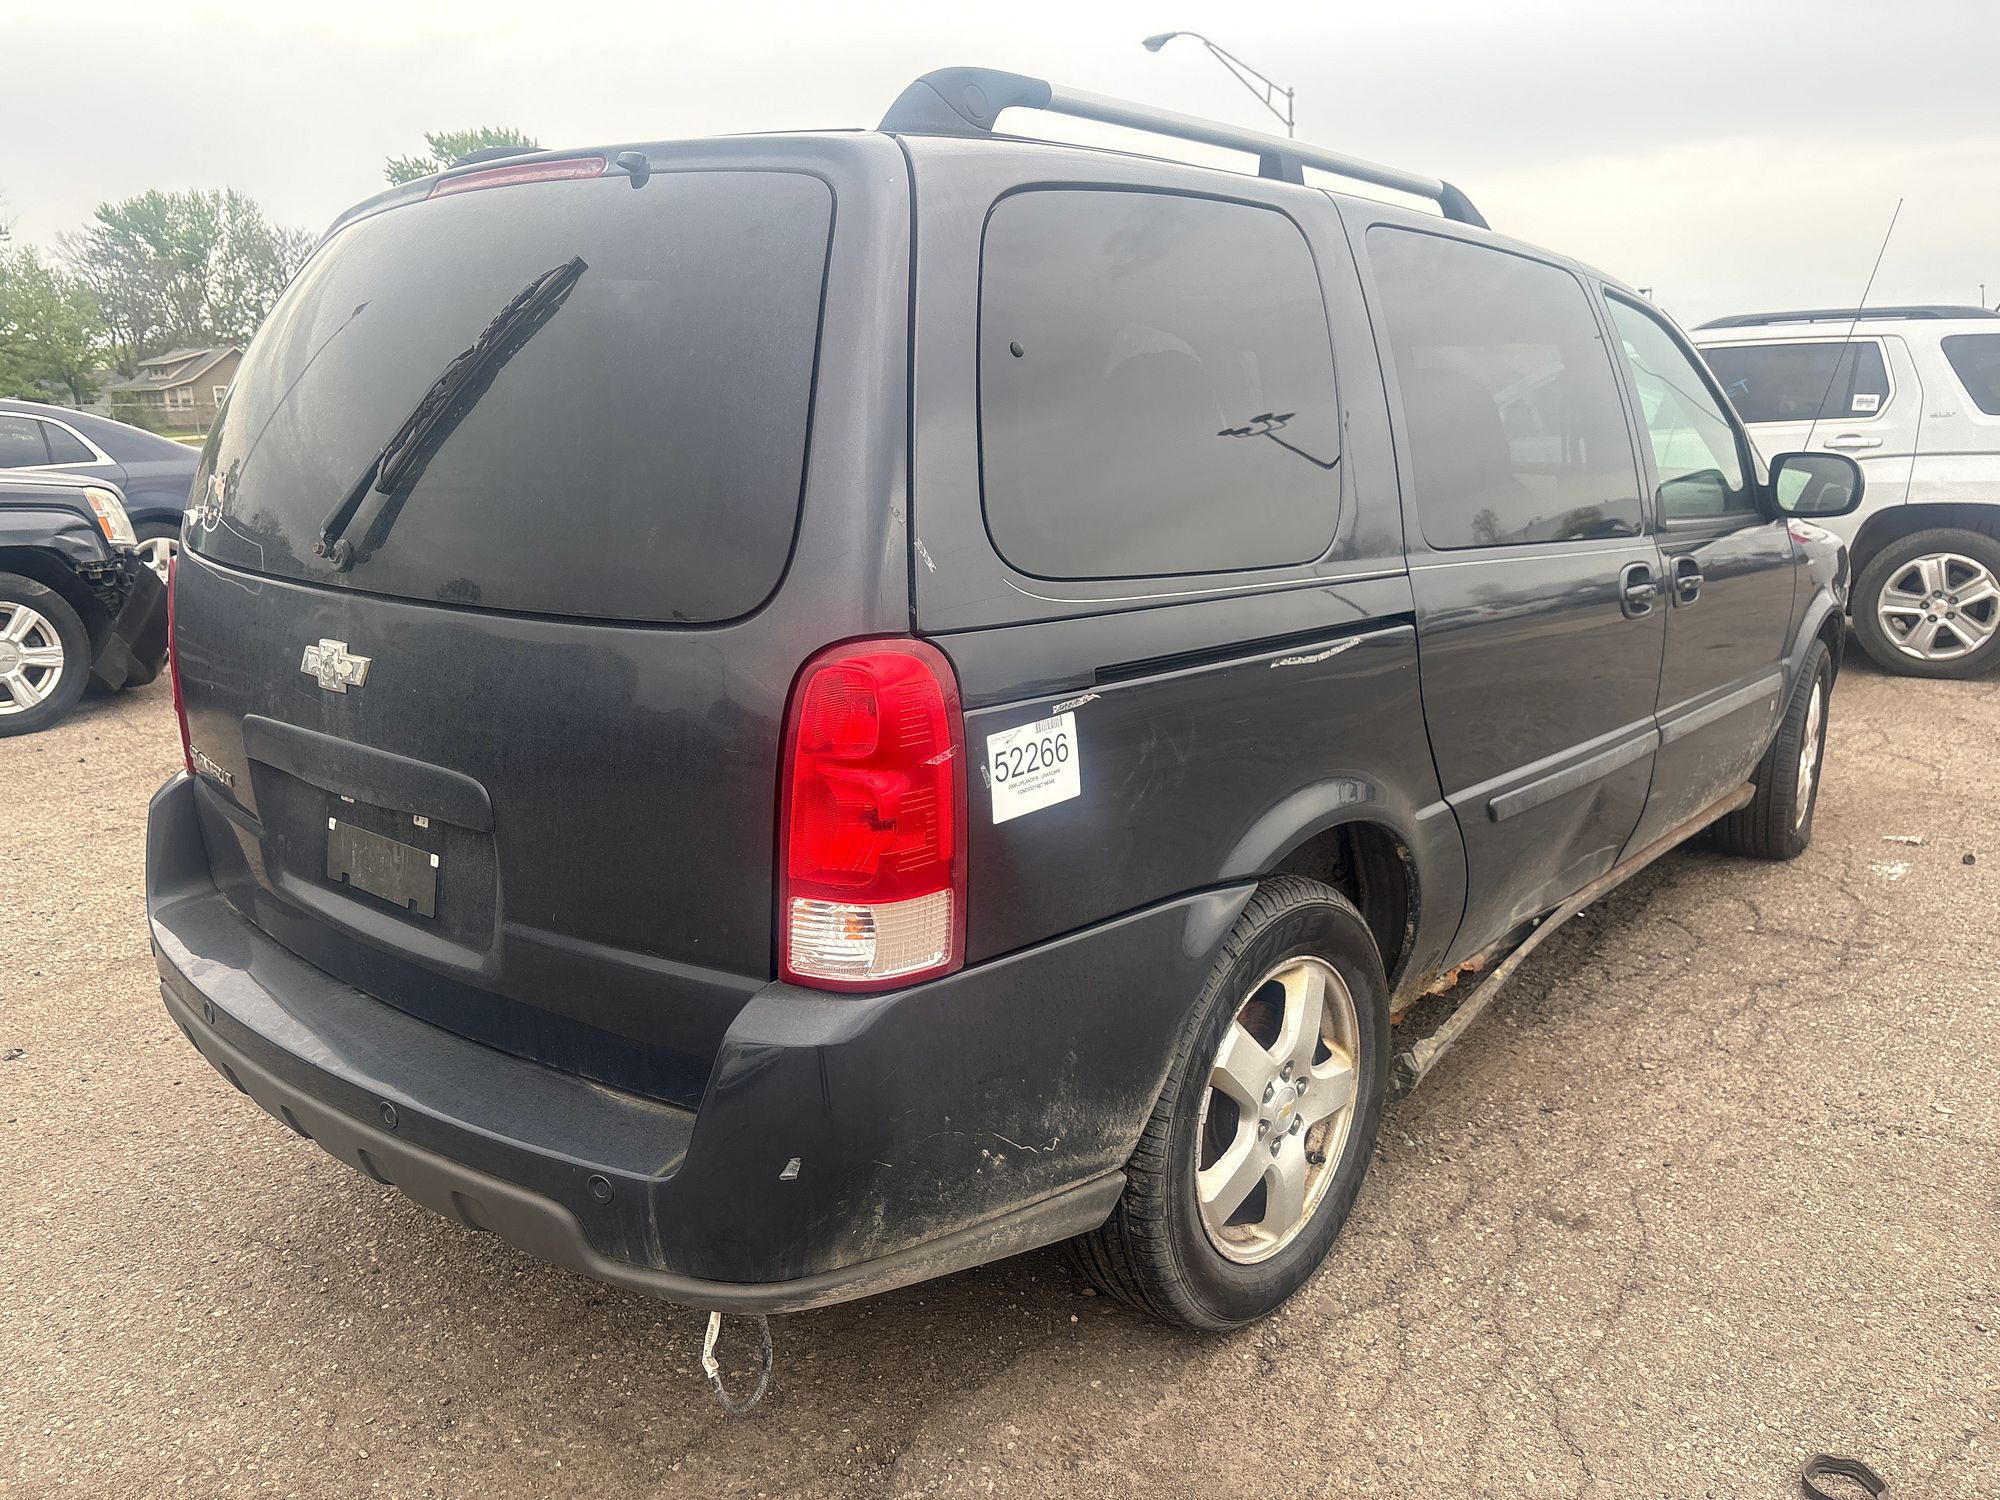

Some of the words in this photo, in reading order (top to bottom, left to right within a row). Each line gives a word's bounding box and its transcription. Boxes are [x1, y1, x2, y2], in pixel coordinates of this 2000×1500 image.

[995, 733, 1069, 782] 52266
[1018, 776, 1038, 787] UPLANDER
[1041, 768, 1060, 779] UNKNOWN
